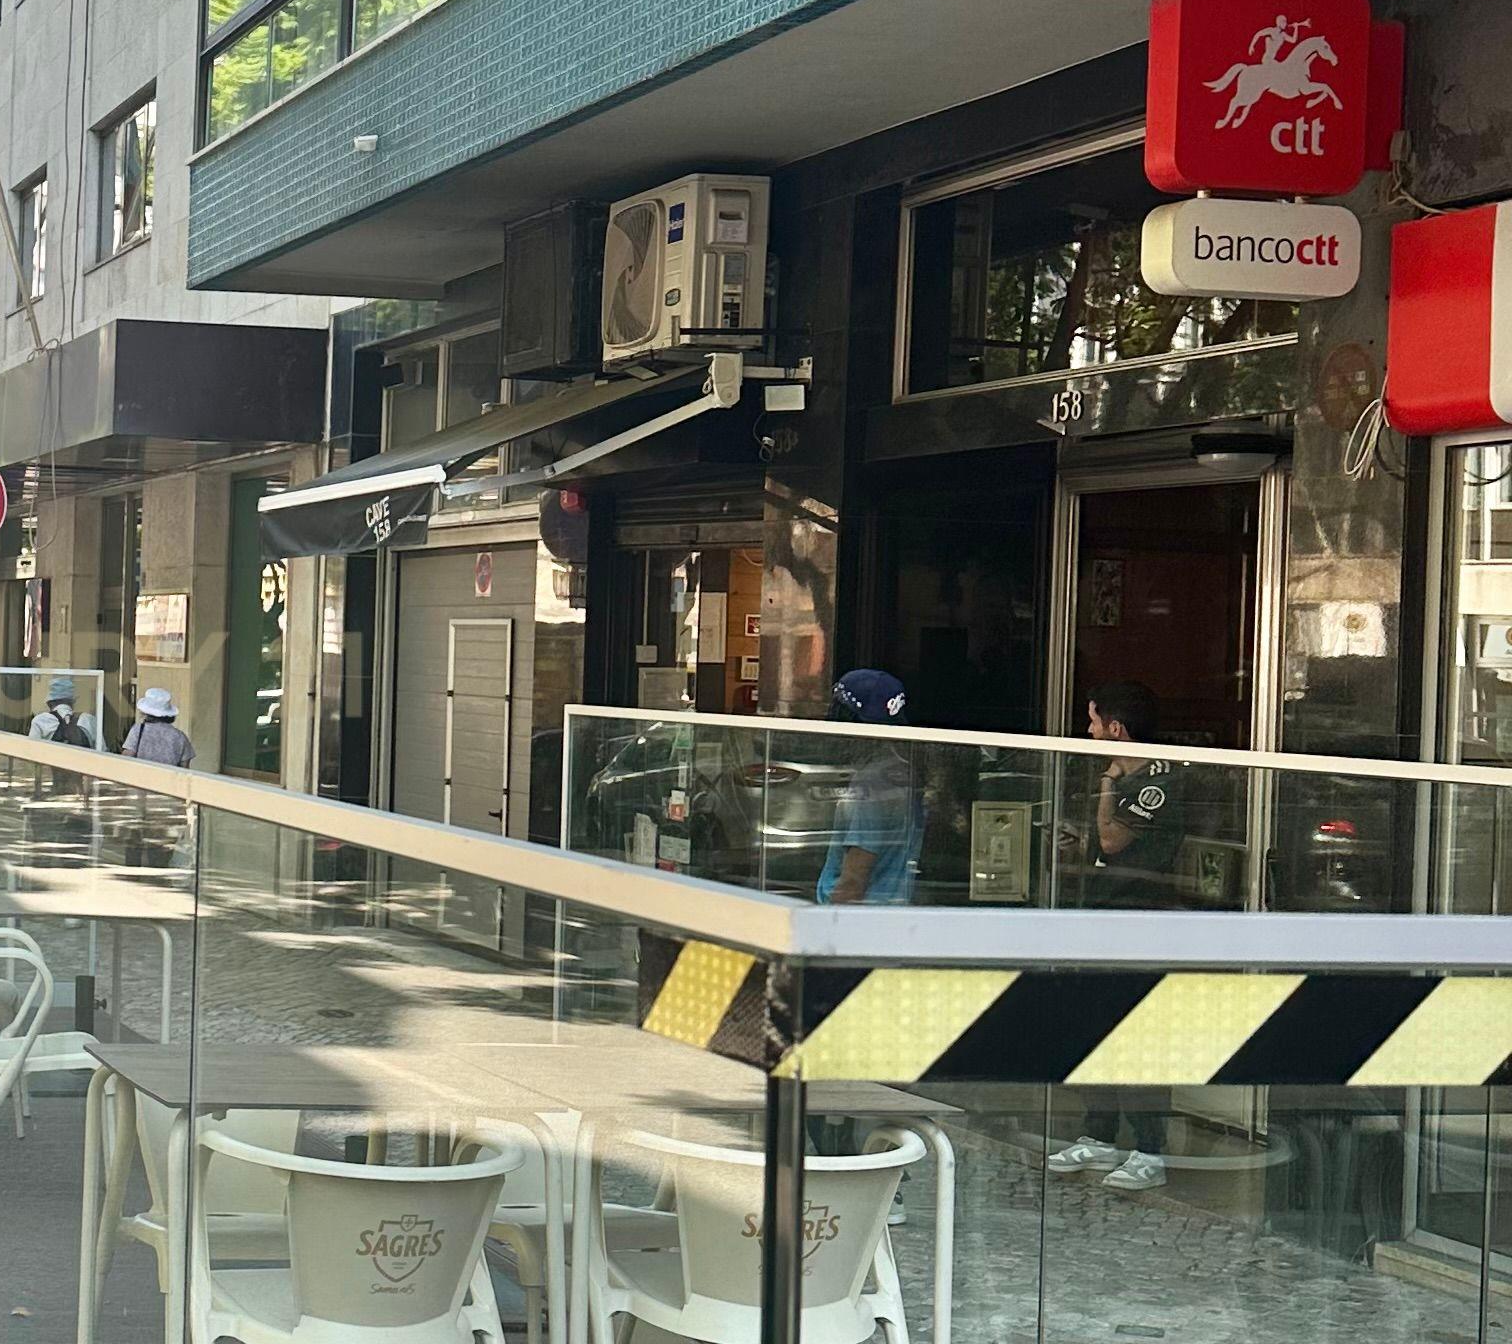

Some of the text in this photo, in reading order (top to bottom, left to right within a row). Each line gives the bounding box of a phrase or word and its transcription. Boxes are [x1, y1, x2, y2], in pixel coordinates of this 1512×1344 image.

[1270, 116, 1325, 156] ctt
[1194, 225, 1339, 266] bancoctt
[1052, 390, 1082, 423] 158
[365, 496, 390, 528] CAVE
[373, 519, 391, 544] 158
[741, 1213, 841, 1241] SRES
[355, 1229, 445, 1258] SAGRES
